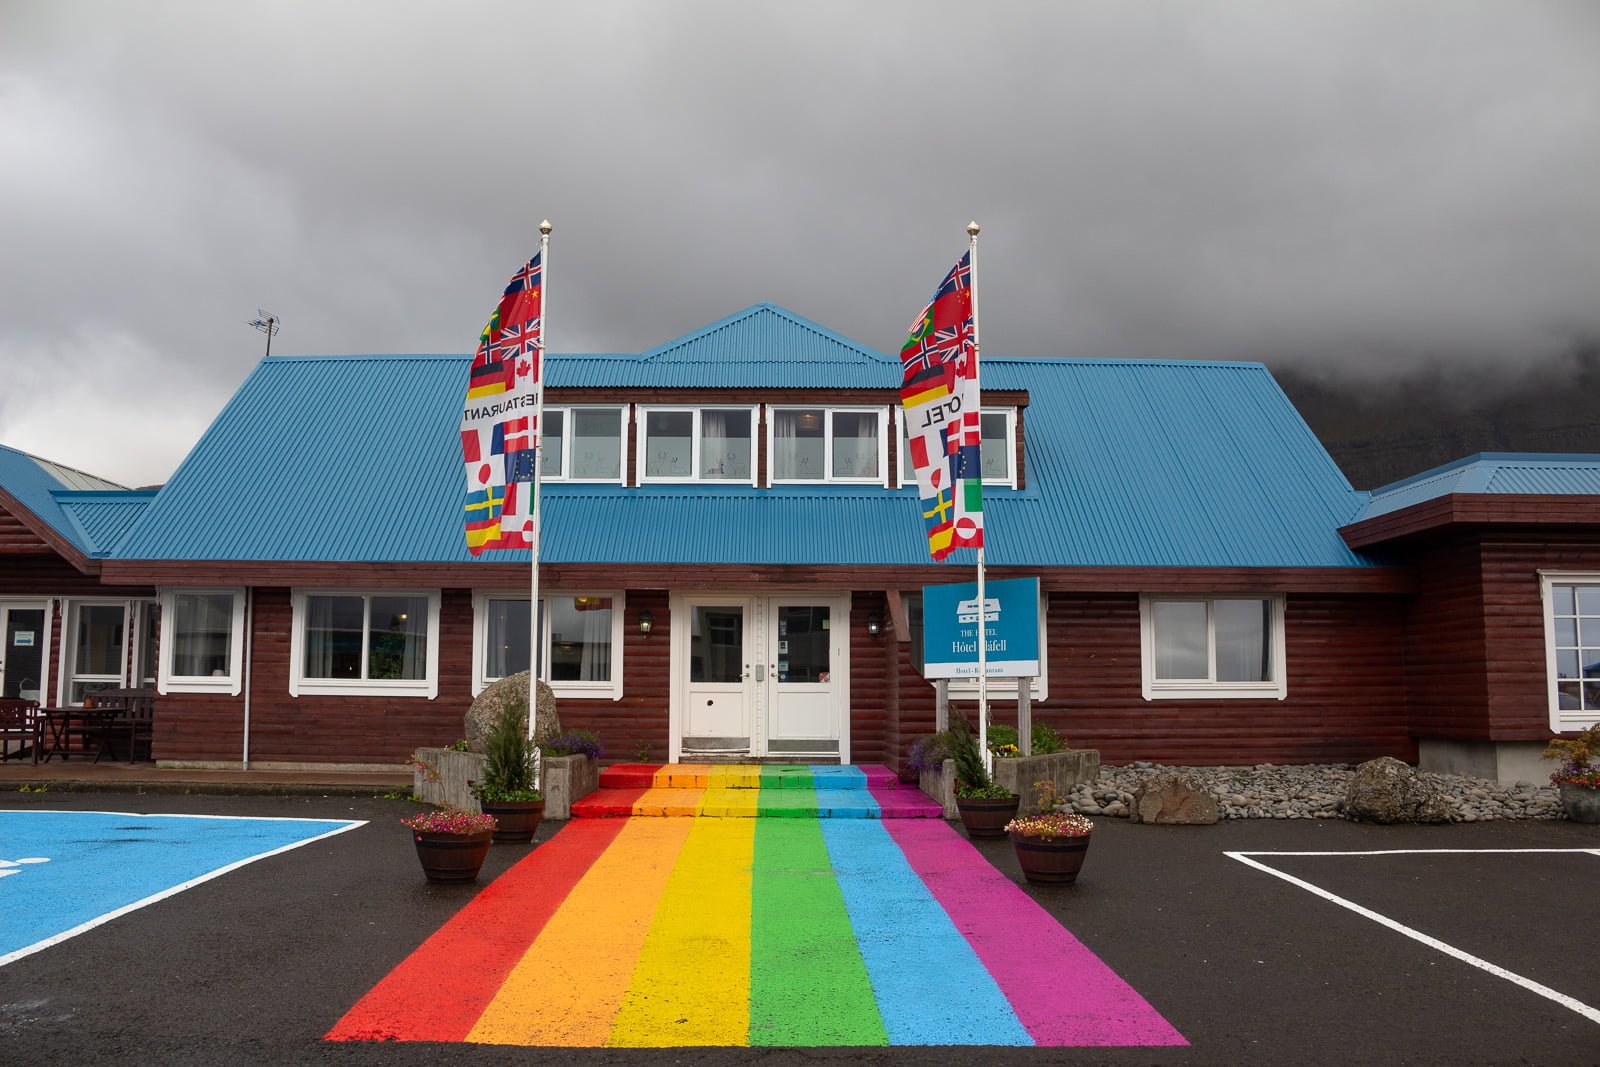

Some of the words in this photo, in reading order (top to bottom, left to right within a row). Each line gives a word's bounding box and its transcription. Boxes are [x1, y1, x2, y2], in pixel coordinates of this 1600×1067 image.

[960, 629, 974, 637] THE
[975, 628, 998, 637] HTEL
[952, 640, 977, 653] Hótel
[984, 639, 1006, 652] láfell
